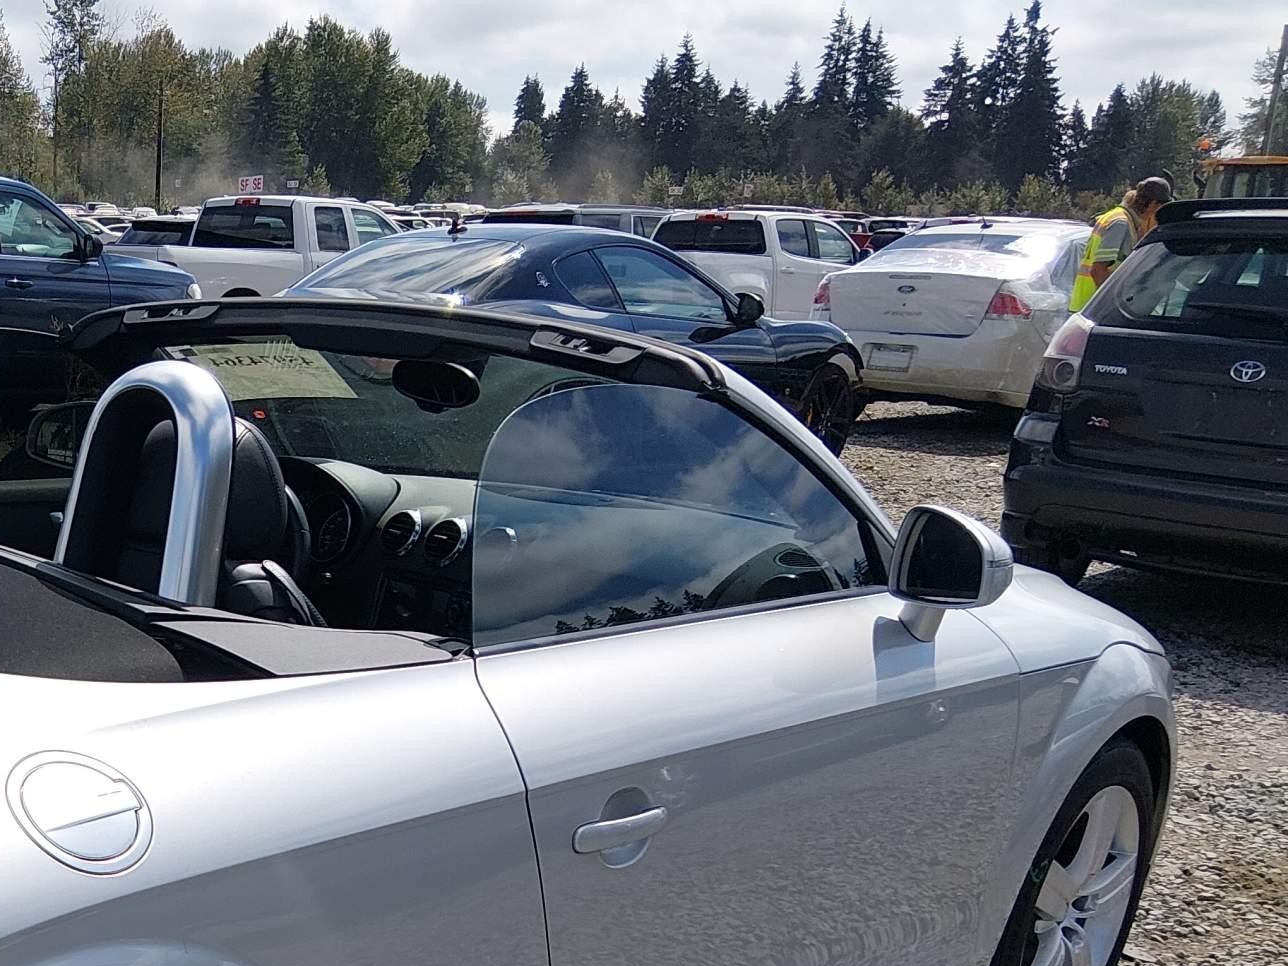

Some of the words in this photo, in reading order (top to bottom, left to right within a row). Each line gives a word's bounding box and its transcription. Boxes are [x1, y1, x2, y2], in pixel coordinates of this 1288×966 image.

[239, 178, 250, 192] SF
[252, 177, 262, 191] SE
[1094, 364, 1128, 376] TOYOTA
